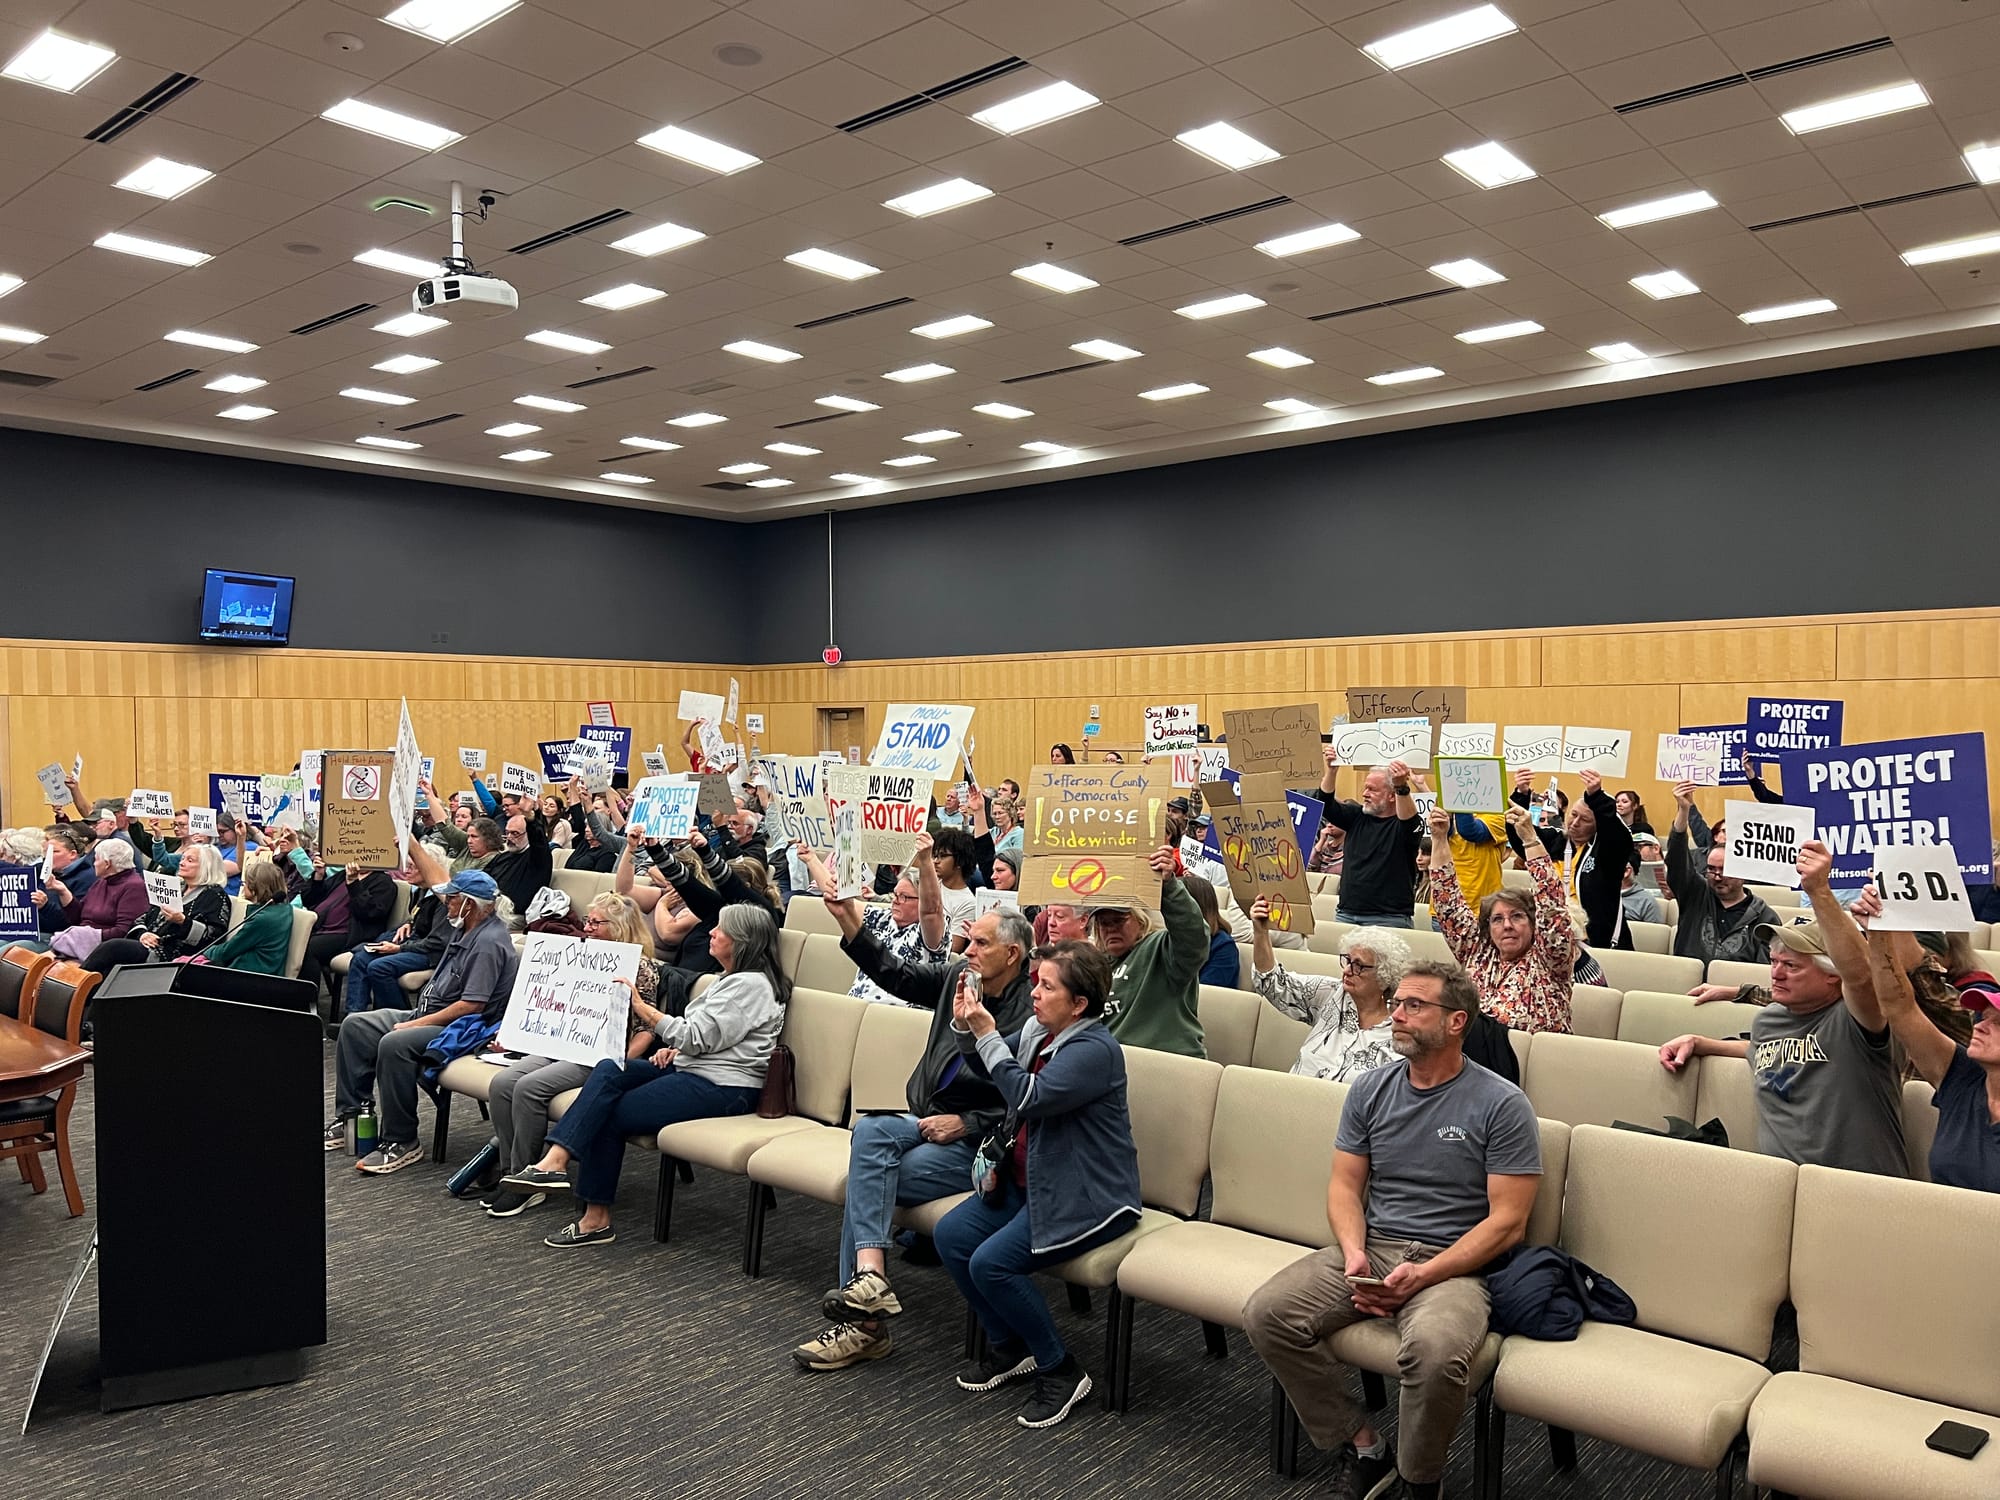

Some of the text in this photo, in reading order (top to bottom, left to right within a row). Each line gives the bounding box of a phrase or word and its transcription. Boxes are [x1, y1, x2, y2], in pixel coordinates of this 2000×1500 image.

[1145, 706, 1190, 719] Say NO to
[1353, 690, 1451, 724] Jefferson County
[1760, 703, 1830, 721] PROTECT
[1271, 707, 1318, 738] County
[1778, 719, 1808, 735] AIR
[586, 729, 625, 742] PROTECT
[886, 721, 951, 749] STAND
[1381, 734, 1419, 752] DON'T
[1666, 735, 1719, 752] PROTECT
[1755, 732, 1830, 750] QUALITY!
[331, 755, 350, 767] Hold
[882, 749, 942, 771] with us
[1679, 753, 1705, 761] OUR
[507, 766, 536, 782] GIVE US
[1444, 763, 1487, 778] JUST
[1659, 762, 1718, 783] WATER
[1807, 749, 1955, 793] PROTECT
[503, 781, 536, 796] CHANCE!
[782, 763, 816, 798] LAW
[868, 775, 880, 795] NO
[883, 775, 914, 798] VALOR
[1042, 770, 1150, 795] Jefferson County
[1455, 777, 1481, 789] SAY
[146, 793, 169, 802] GIVE US
[650, 787, 697, 807] PROTECT
[1061, 789, 1129, 803] Democrats
[1848, 788, 1911, 821] THE
[146, 807, 173, 816] CHANCE!
[328, 803, 377, 816] Protect Our
[660, 804, 680, 816] OUR
[789, 801, 805, 815] on
[191, 821, 213, 830] GIVE IN!
[193, 814, 210, 822] DON'T
[338, 817, 365, 827] Water
[645, 815, 688, 836] WATER
[1051, 808, 1139, 826] OPPOSE
[1045, 828, 1138, 848] Sidewinder
[1743, 822, 1796, 845] STAND
[1817, 816, 1953, 856] WATER!
[326, 846, 336, 856] No
[1181, 847, 1206, 864] SUPPORT
[1190, 843, 1199, 853] WE
[1734, 839, 1800, 865] STRONG
[1185, 857, 1197, 868] YOU
[0, 874, 28, 891] OTECT
[148, 883, 179, 898] SUPPORT
[155, 878, 167, 887] WE
[1875, 871, 1919, 901] 1.3
[1924, 871, 1959, 901] D.
[2, 891, 18, 908] AIR
[156, 895, 170, 905] YOU
[0, 907, 32, 924] ALITY!
[524, 969, 607, 1003] protect preserve
[519, 1008, 601, 1048] Justice will Prevail
